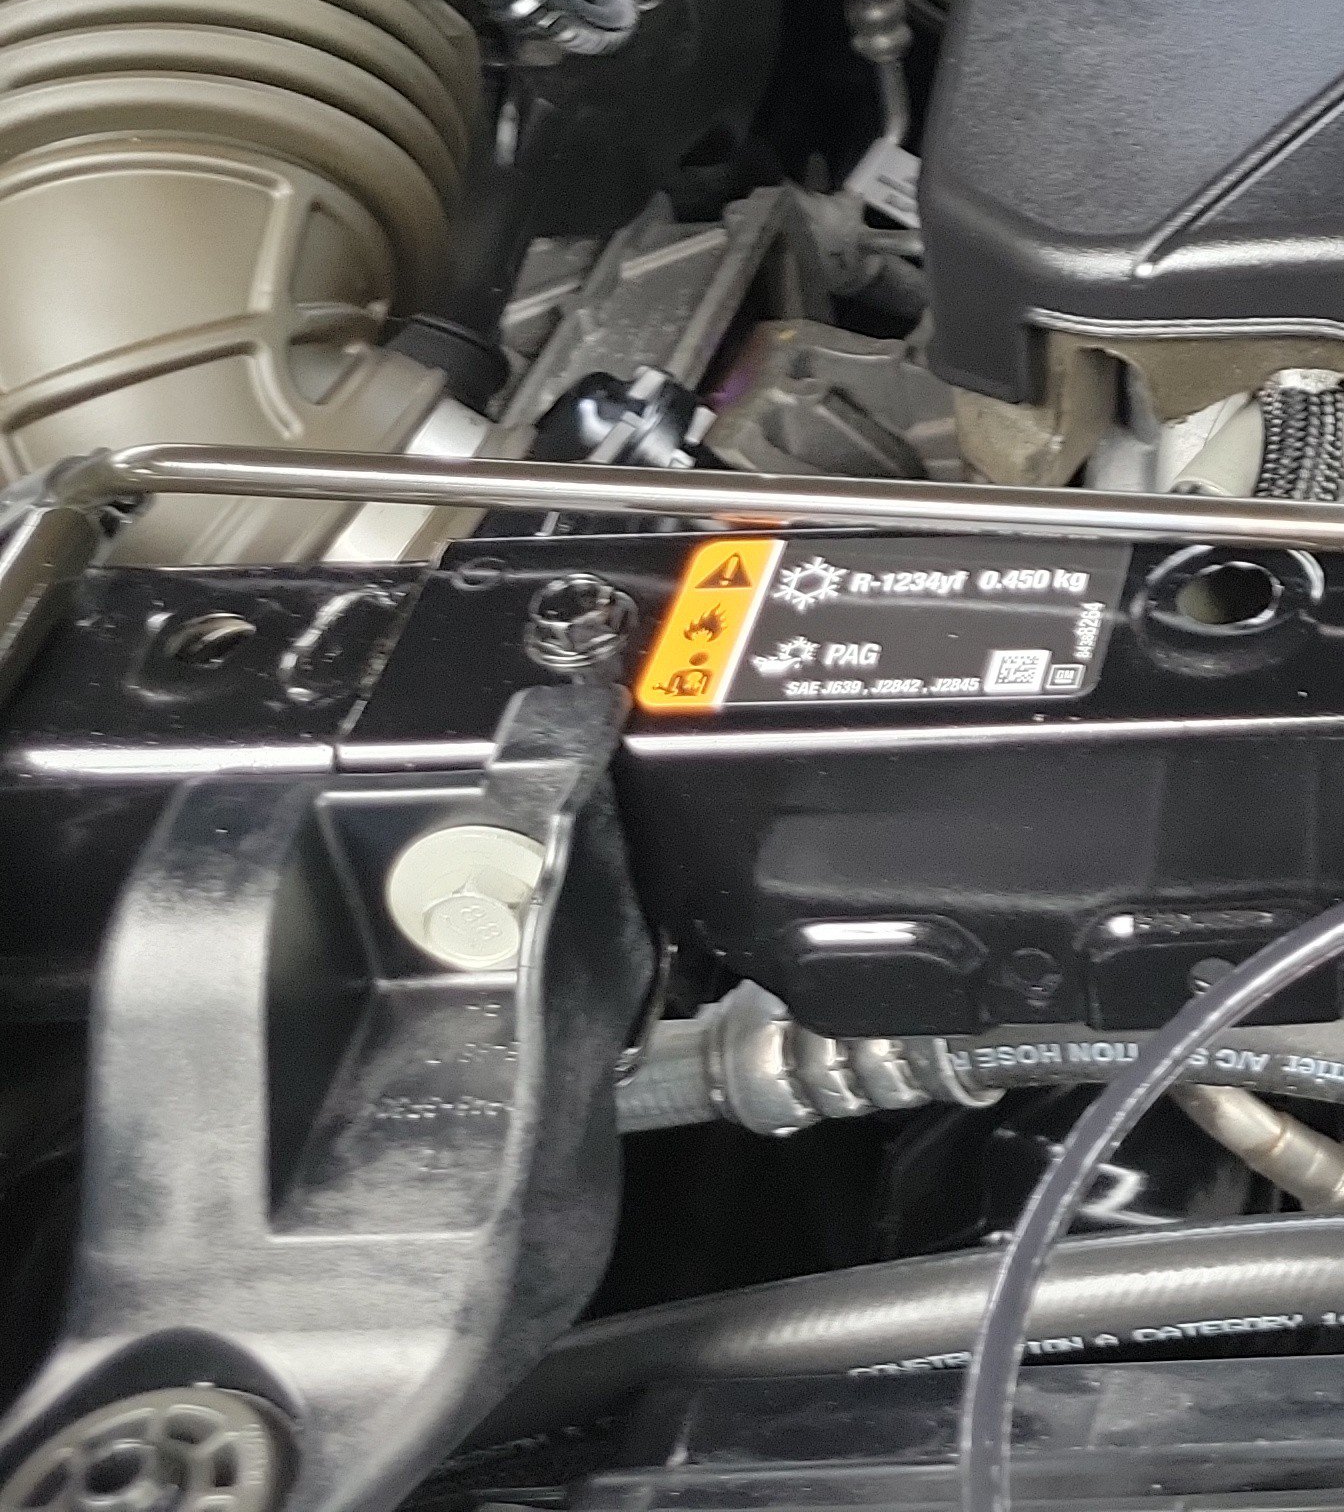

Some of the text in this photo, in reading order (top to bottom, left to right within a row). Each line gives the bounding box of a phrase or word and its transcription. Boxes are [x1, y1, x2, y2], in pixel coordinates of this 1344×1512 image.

[850, 569, 1089, 595] R-1234yf 0.450 kg
[823, 643, 881, 667] PAG
[786, 680, 820, 696] SAE
[975, 1043, 1062, 1070] HOSE
[1215, 1047, 1270, 1071] A/C
